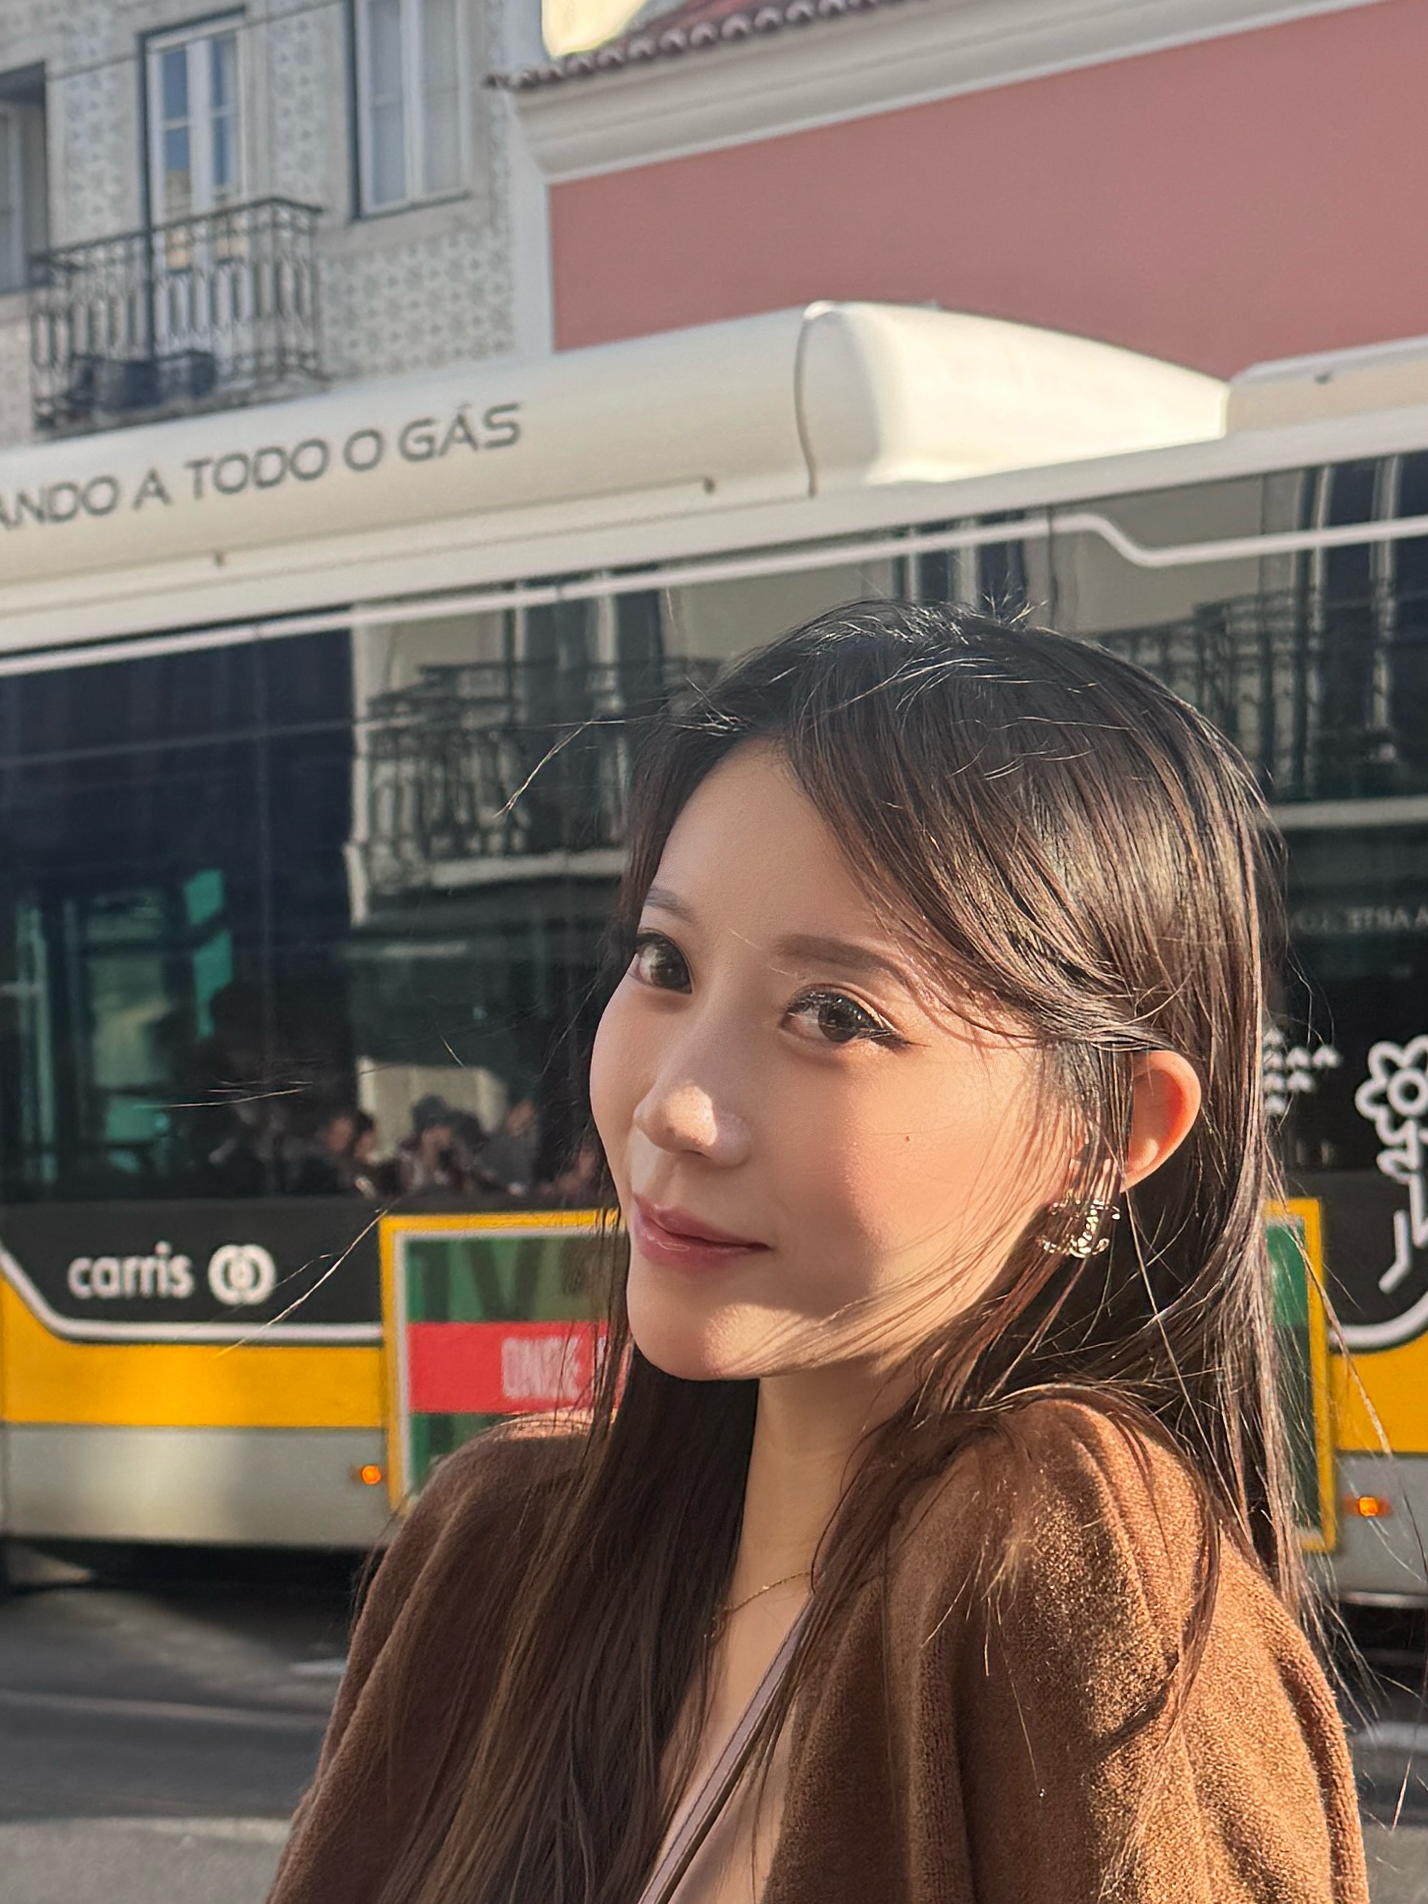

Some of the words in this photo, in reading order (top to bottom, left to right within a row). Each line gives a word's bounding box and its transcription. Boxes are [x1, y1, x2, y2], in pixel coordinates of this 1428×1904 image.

[132, 467, 174, 511] A
[184, 437, 329, 501] TODO
[342, 427, 385, 472] O
[398, 402, 522, 462] GÁS
[67, 1240, 195, 1299] carris
